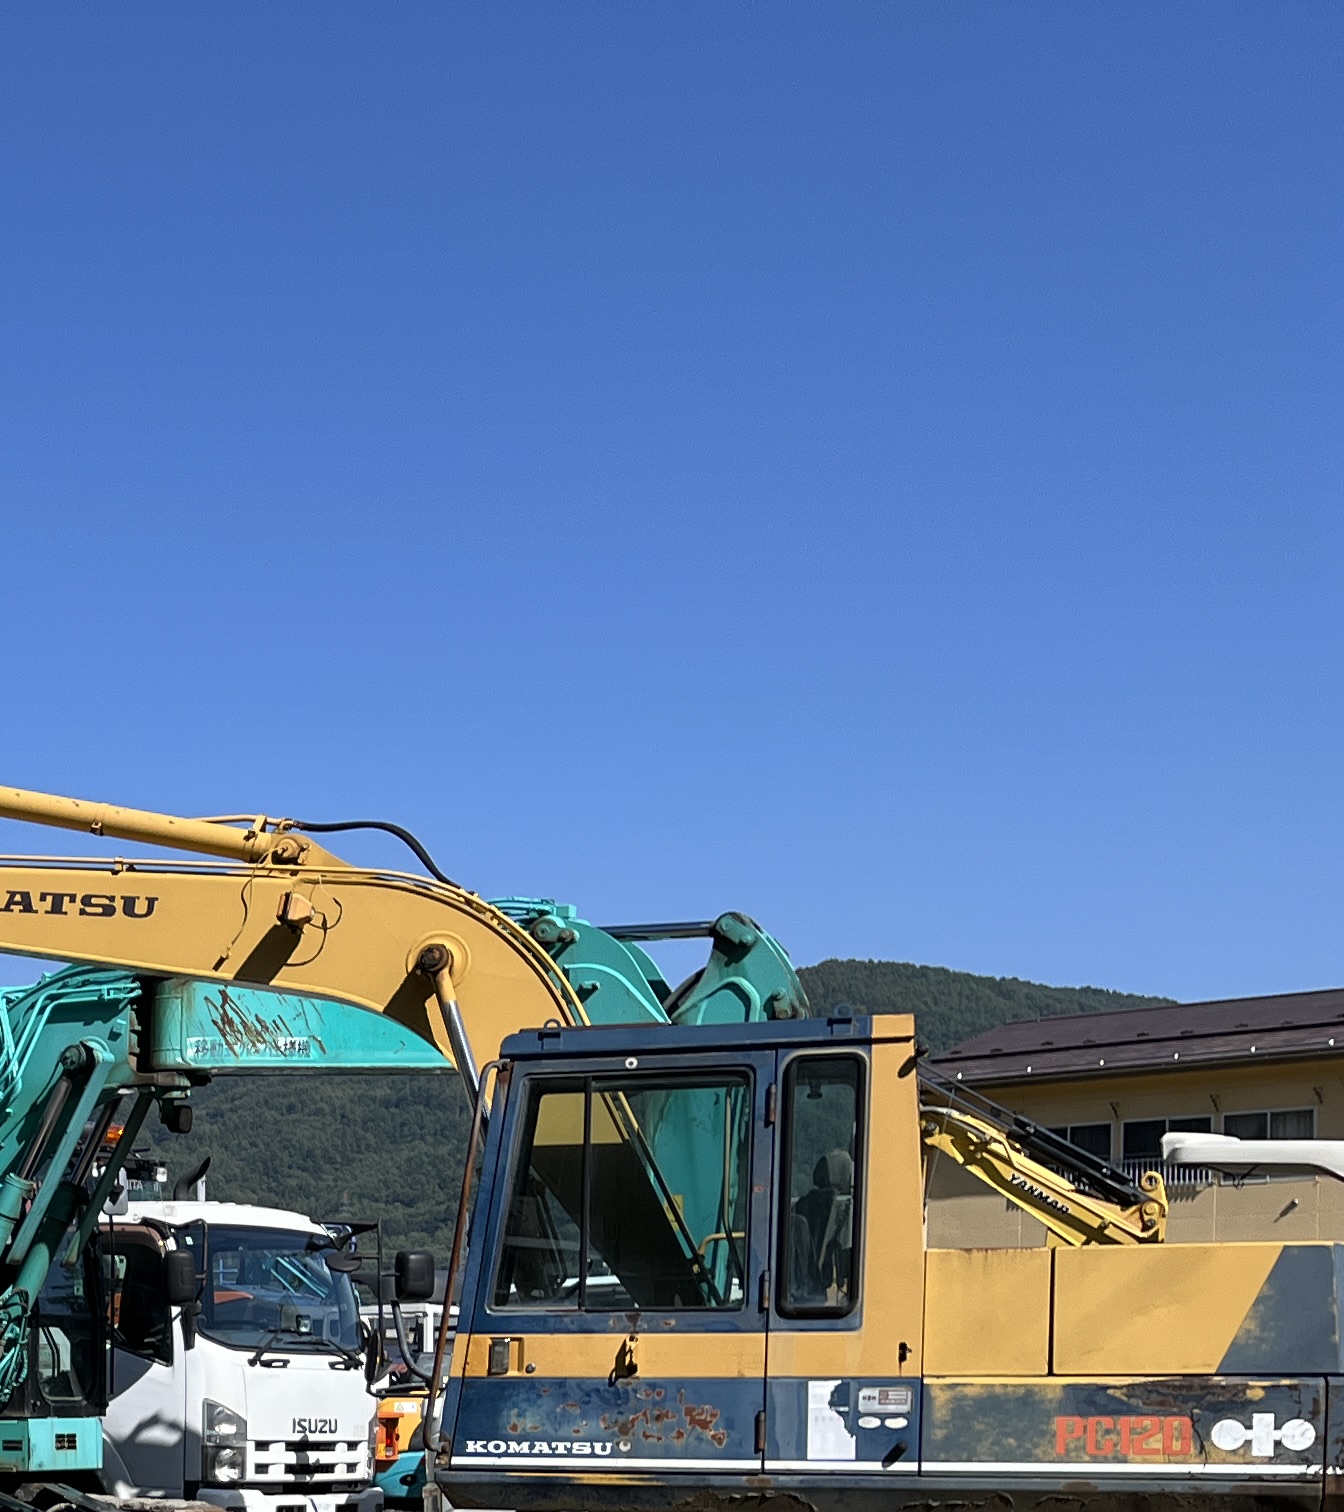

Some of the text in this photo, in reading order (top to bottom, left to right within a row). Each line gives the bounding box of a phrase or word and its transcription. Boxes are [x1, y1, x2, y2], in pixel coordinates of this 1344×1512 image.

[1011, 1173, 1070, 1215] YANMAR
[292, 1418, 338, 1434] ISUZU
[1055, 1415, 1193, 1456] PC120
[465, 1440, 613, 1456] KOMATSU
